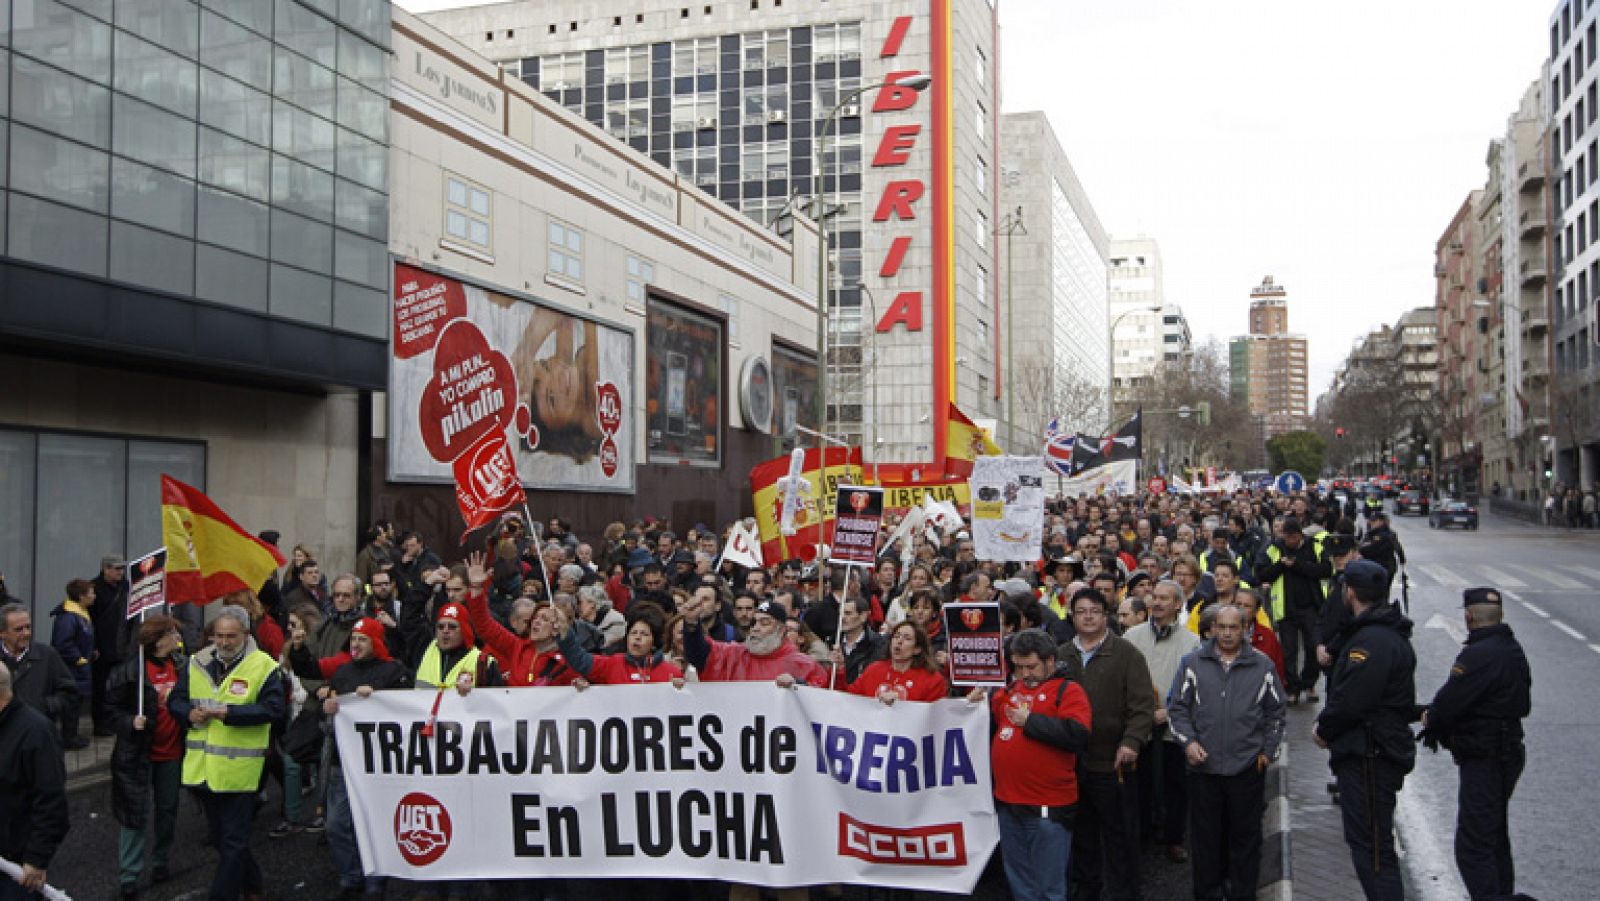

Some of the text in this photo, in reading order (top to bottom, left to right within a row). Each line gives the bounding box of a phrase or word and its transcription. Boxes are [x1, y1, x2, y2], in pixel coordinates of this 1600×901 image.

[871, 16, 925, 334] IBERIA
[439, 386, 455, 406] YO
[441, 387, 504, 447] pikolin
[354, 714, 978, 793] TRABAJADORES de IBERIA
[399, 804, 442, 834] UGT
[511, 789, 785, 865] En LUCHA
[847, 823, 957, 859] CCOO
